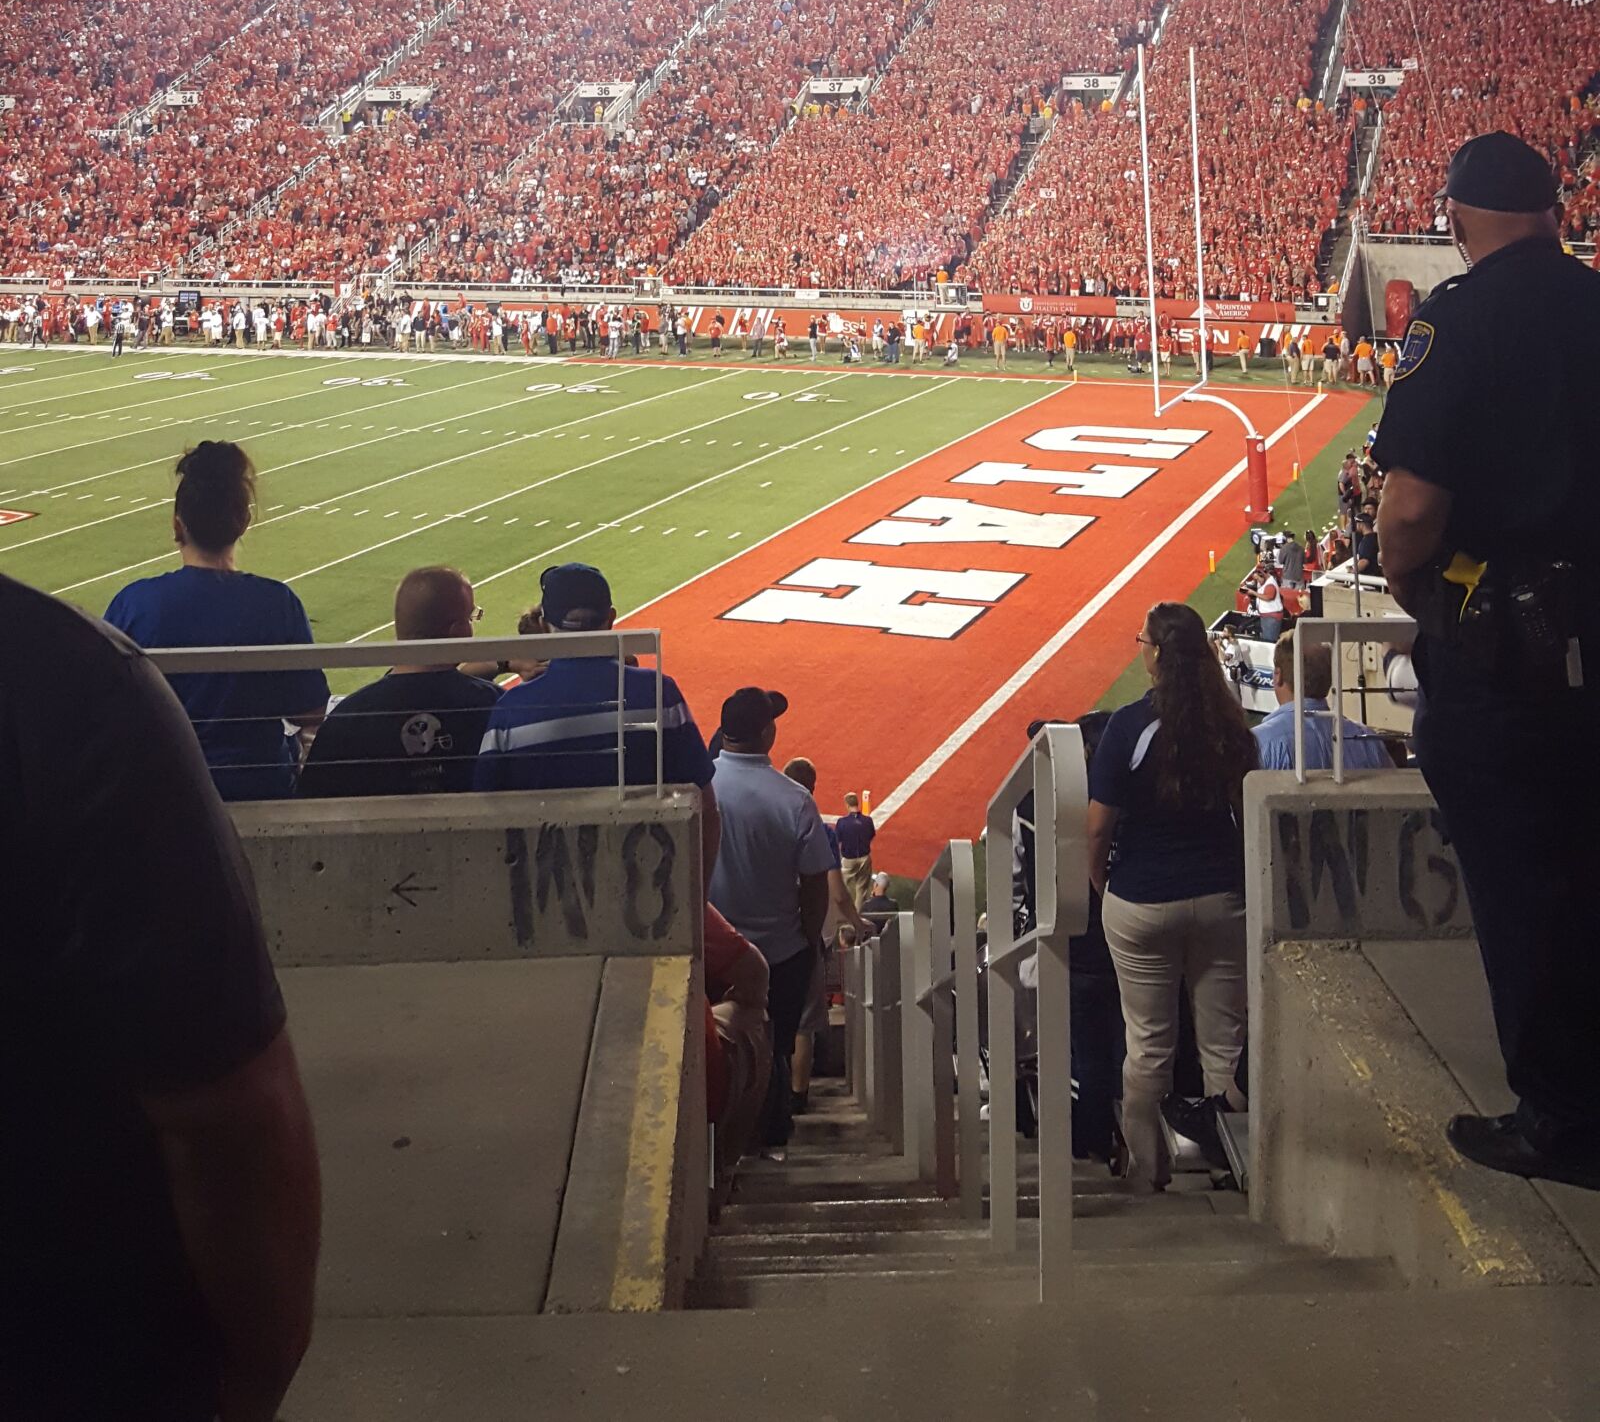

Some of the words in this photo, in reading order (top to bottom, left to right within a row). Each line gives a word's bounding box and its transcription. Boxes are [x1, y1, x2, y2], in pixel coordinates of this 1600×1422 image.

[1083, 78, 1100, 89] 38
[1368, 74, 1386, 85] 39
[597, 87, 610, 96] 36
[829, 82, 843, 92] 37
[181, 95, 194, 104] 34
[389, 91, 402, 100] 35
[714, 424, 1214, 641] UTAH
